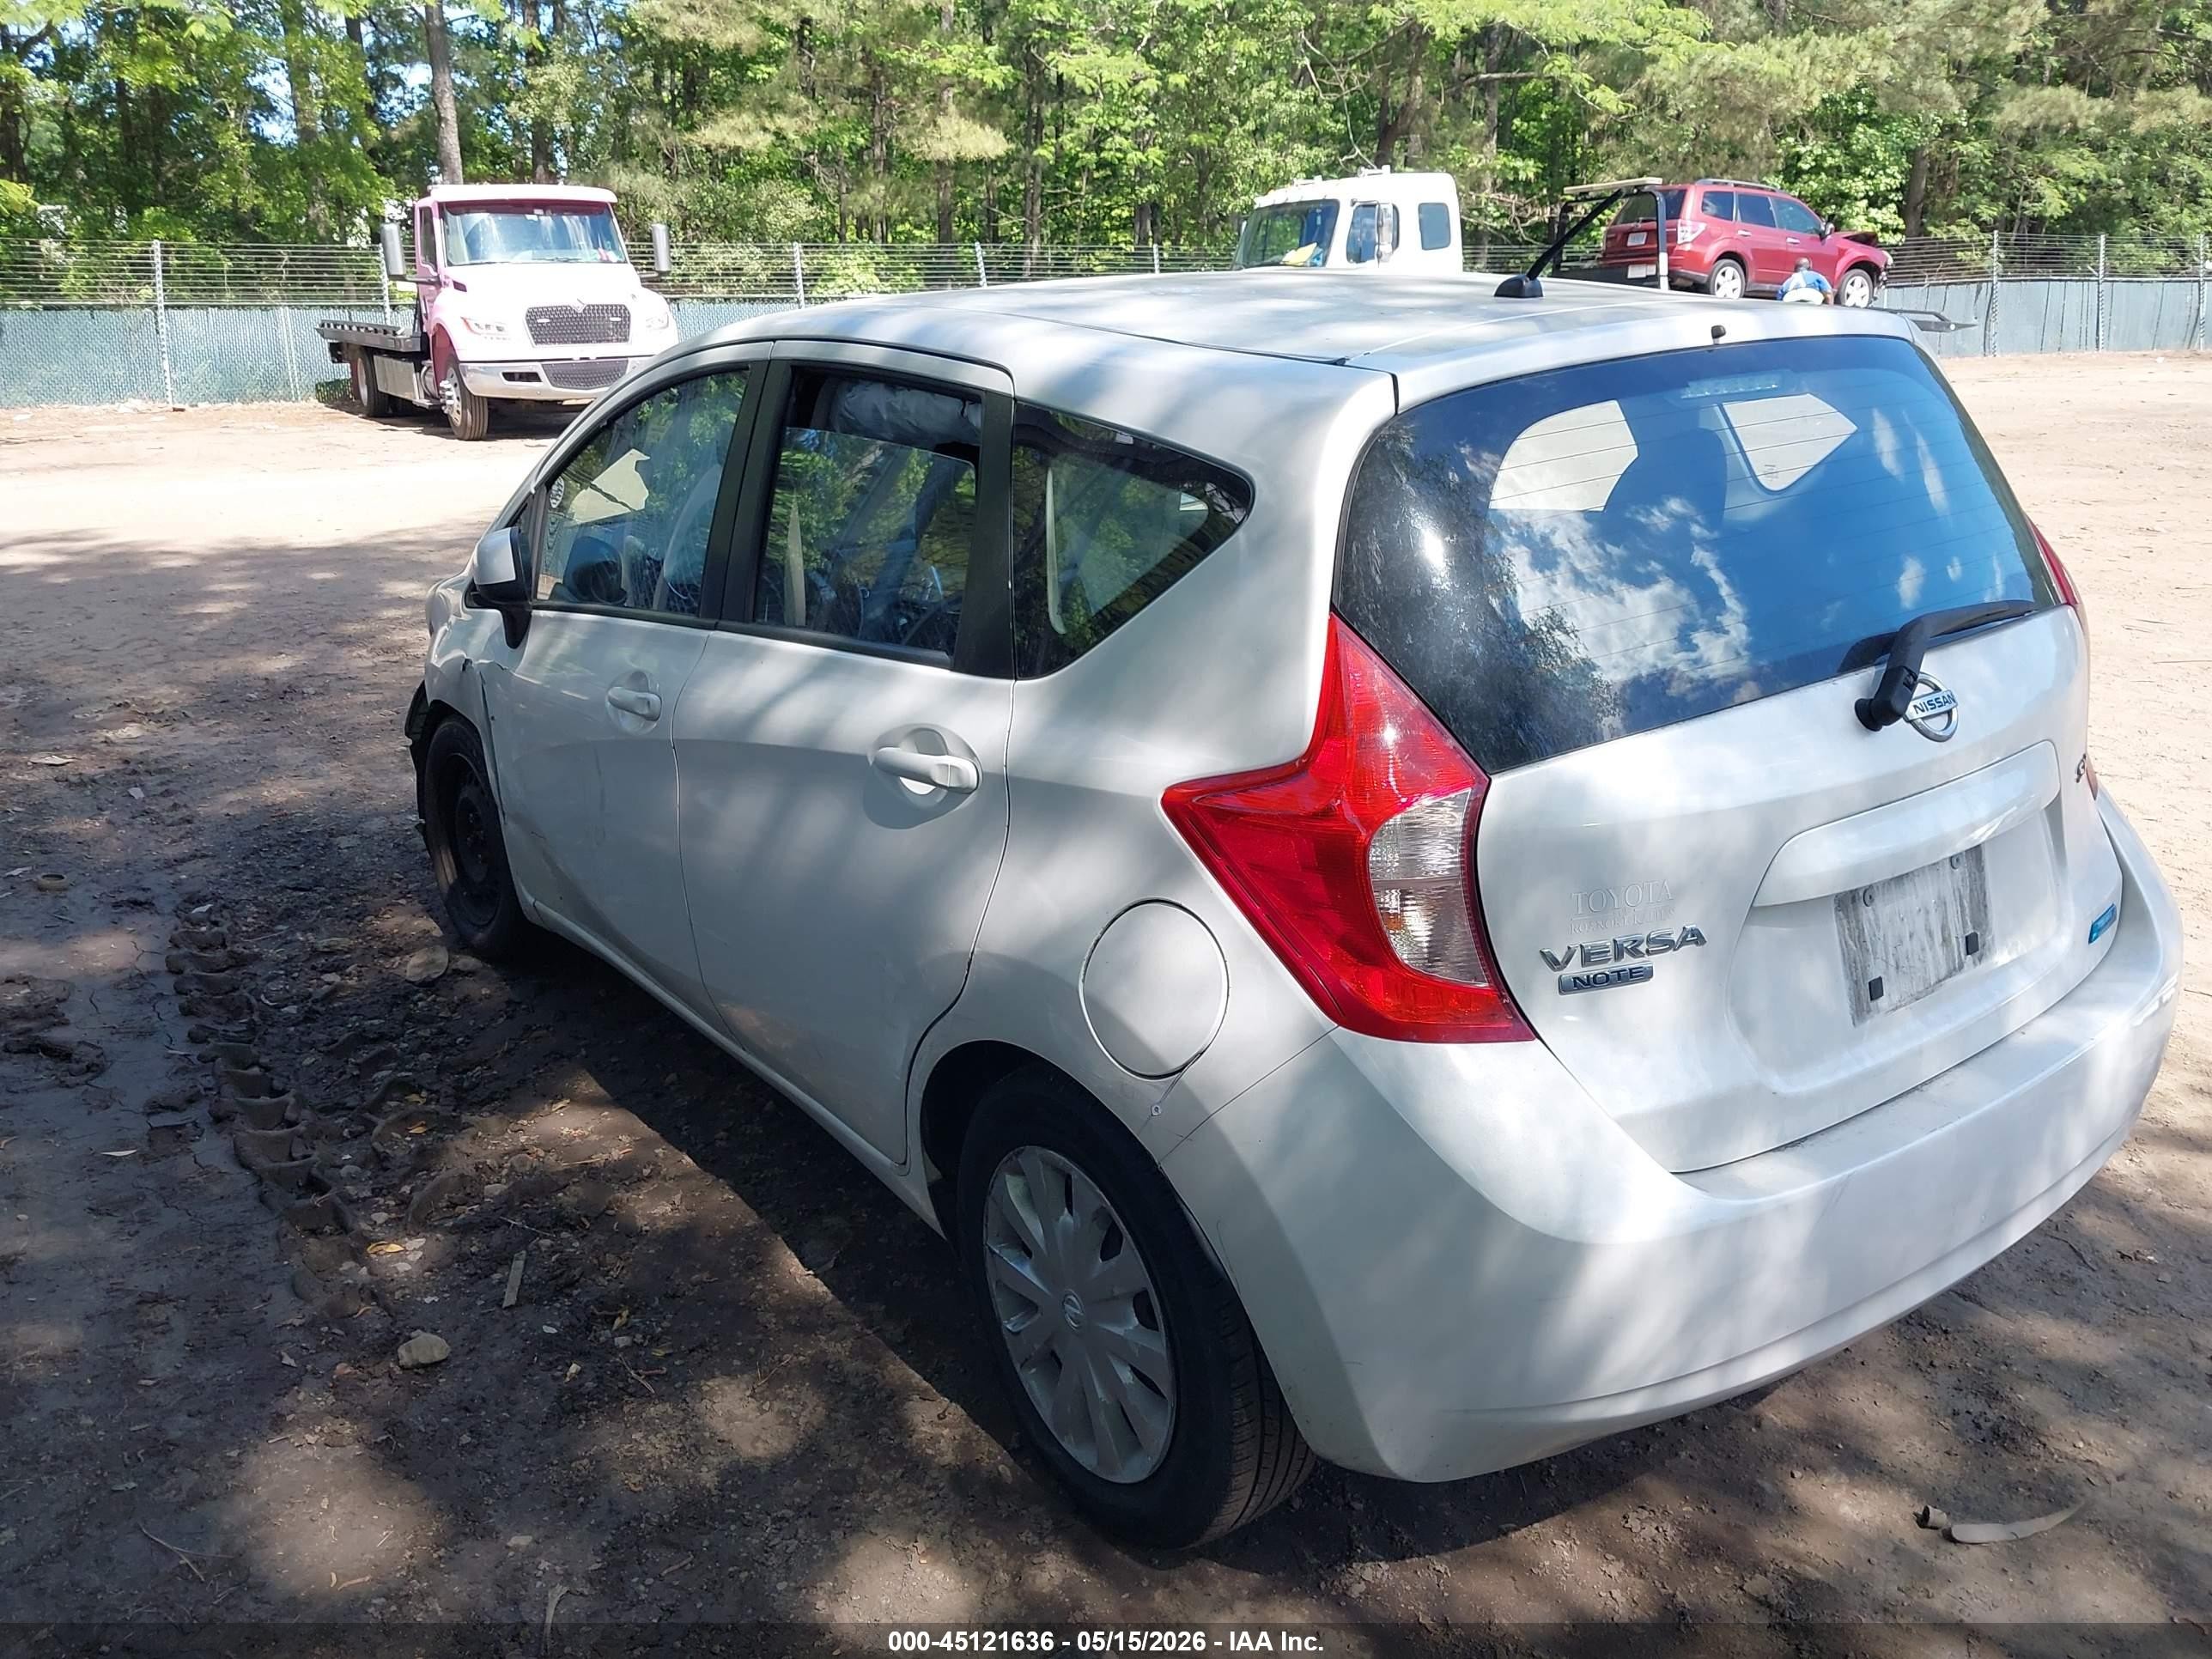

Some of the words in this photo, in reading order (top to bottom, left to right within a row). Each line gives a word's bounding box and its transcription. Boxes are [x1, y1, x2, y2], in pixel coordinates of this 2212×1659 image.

[1912, 693, 1956, 714] NISSAN
[1571, 879, 1674, 915] TOYOTA
[1539, 923, 1707, 972] VERSA
[1571, 965, 1646, 990] NOTE
